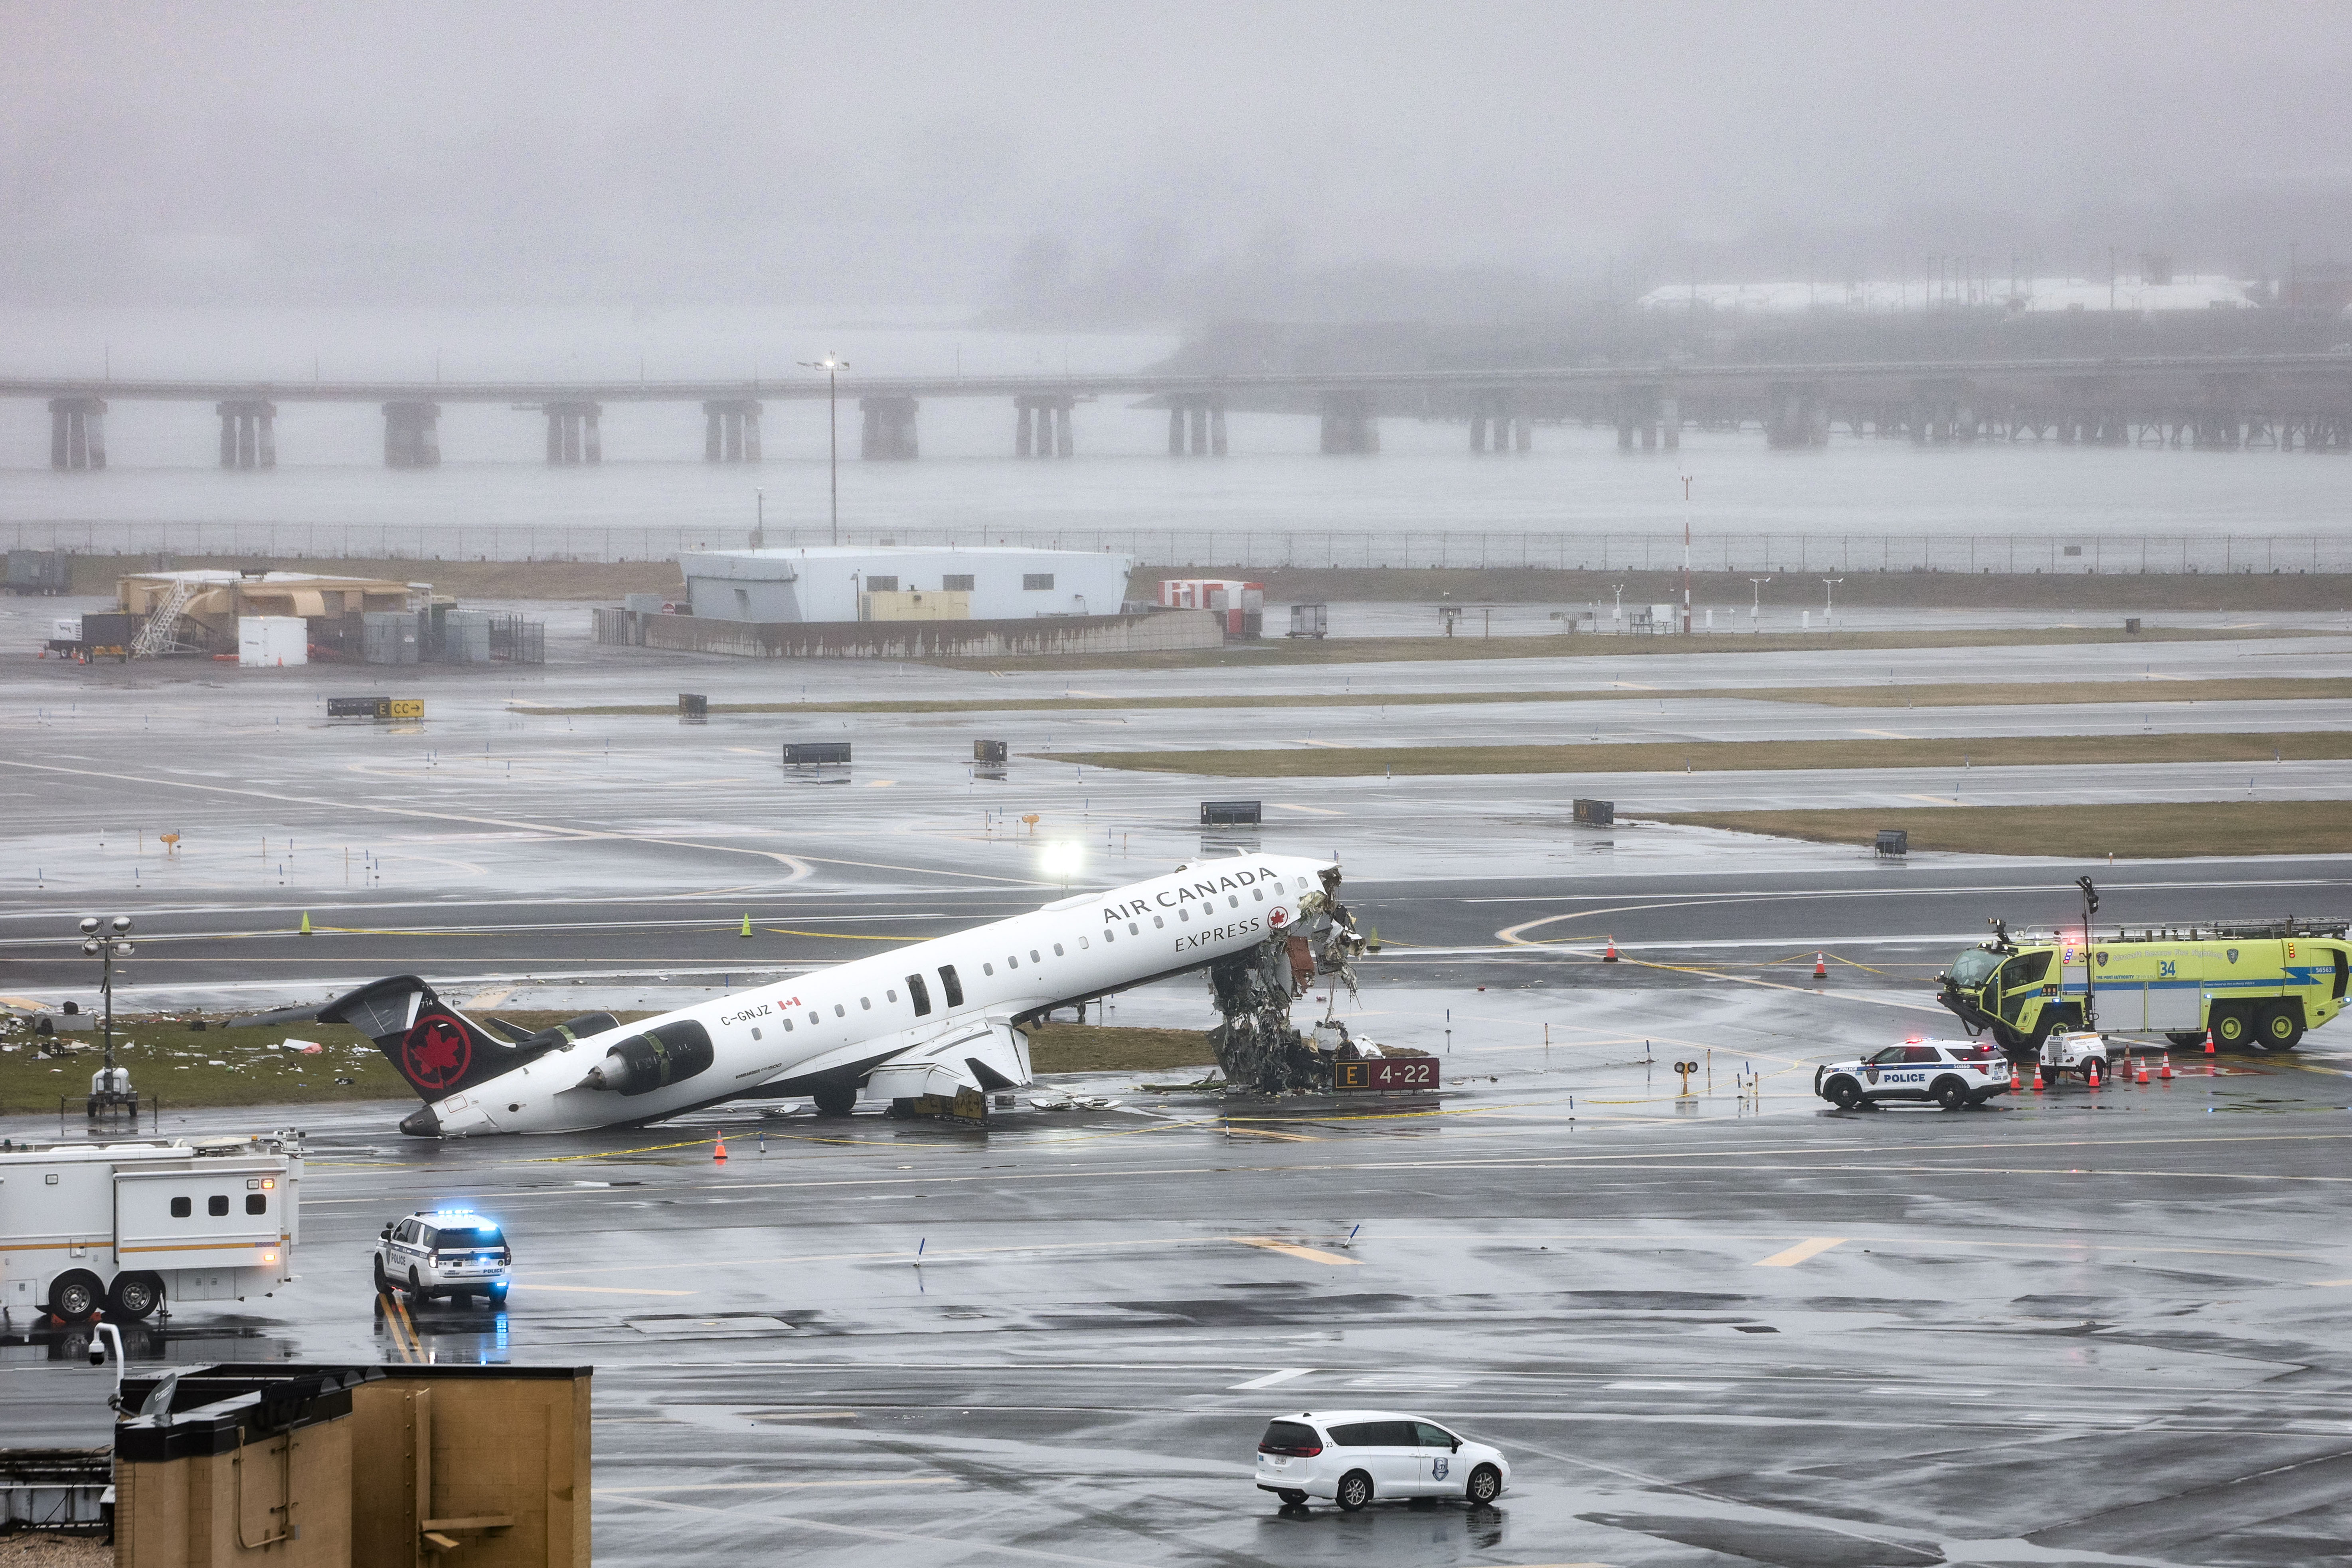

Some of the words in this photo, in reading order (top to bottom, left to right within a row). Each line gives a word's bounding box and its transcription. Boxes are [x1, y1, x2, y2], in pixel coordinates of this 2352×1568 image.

[379, 704, 386, 714] E
[394, 703, 409, 714] CC
[1104, 900, 1152, 923] AIR
[1156, 867, 1277, 907] CANADA
[1176, 917, 1259, 953] EXPRESS
[2113, 951, 2142, 961] Aircraft
[2192, 949, 2223, 959] Fighting
[2160, 961, 2176, 977] 34
[421, 999, 433, 1008] 714
[721, 1005, 772, 1026] C-GNJZ
[735, 1069, 760, 1080] BOMBARDIER
[1347, 1066, 1358, 1084] E
[1380, 1064, 1429, 1083] 4-22
[1884, 1074, 1925, 1083] POLICE
[391, 1253, 406, 1265] POLICE
